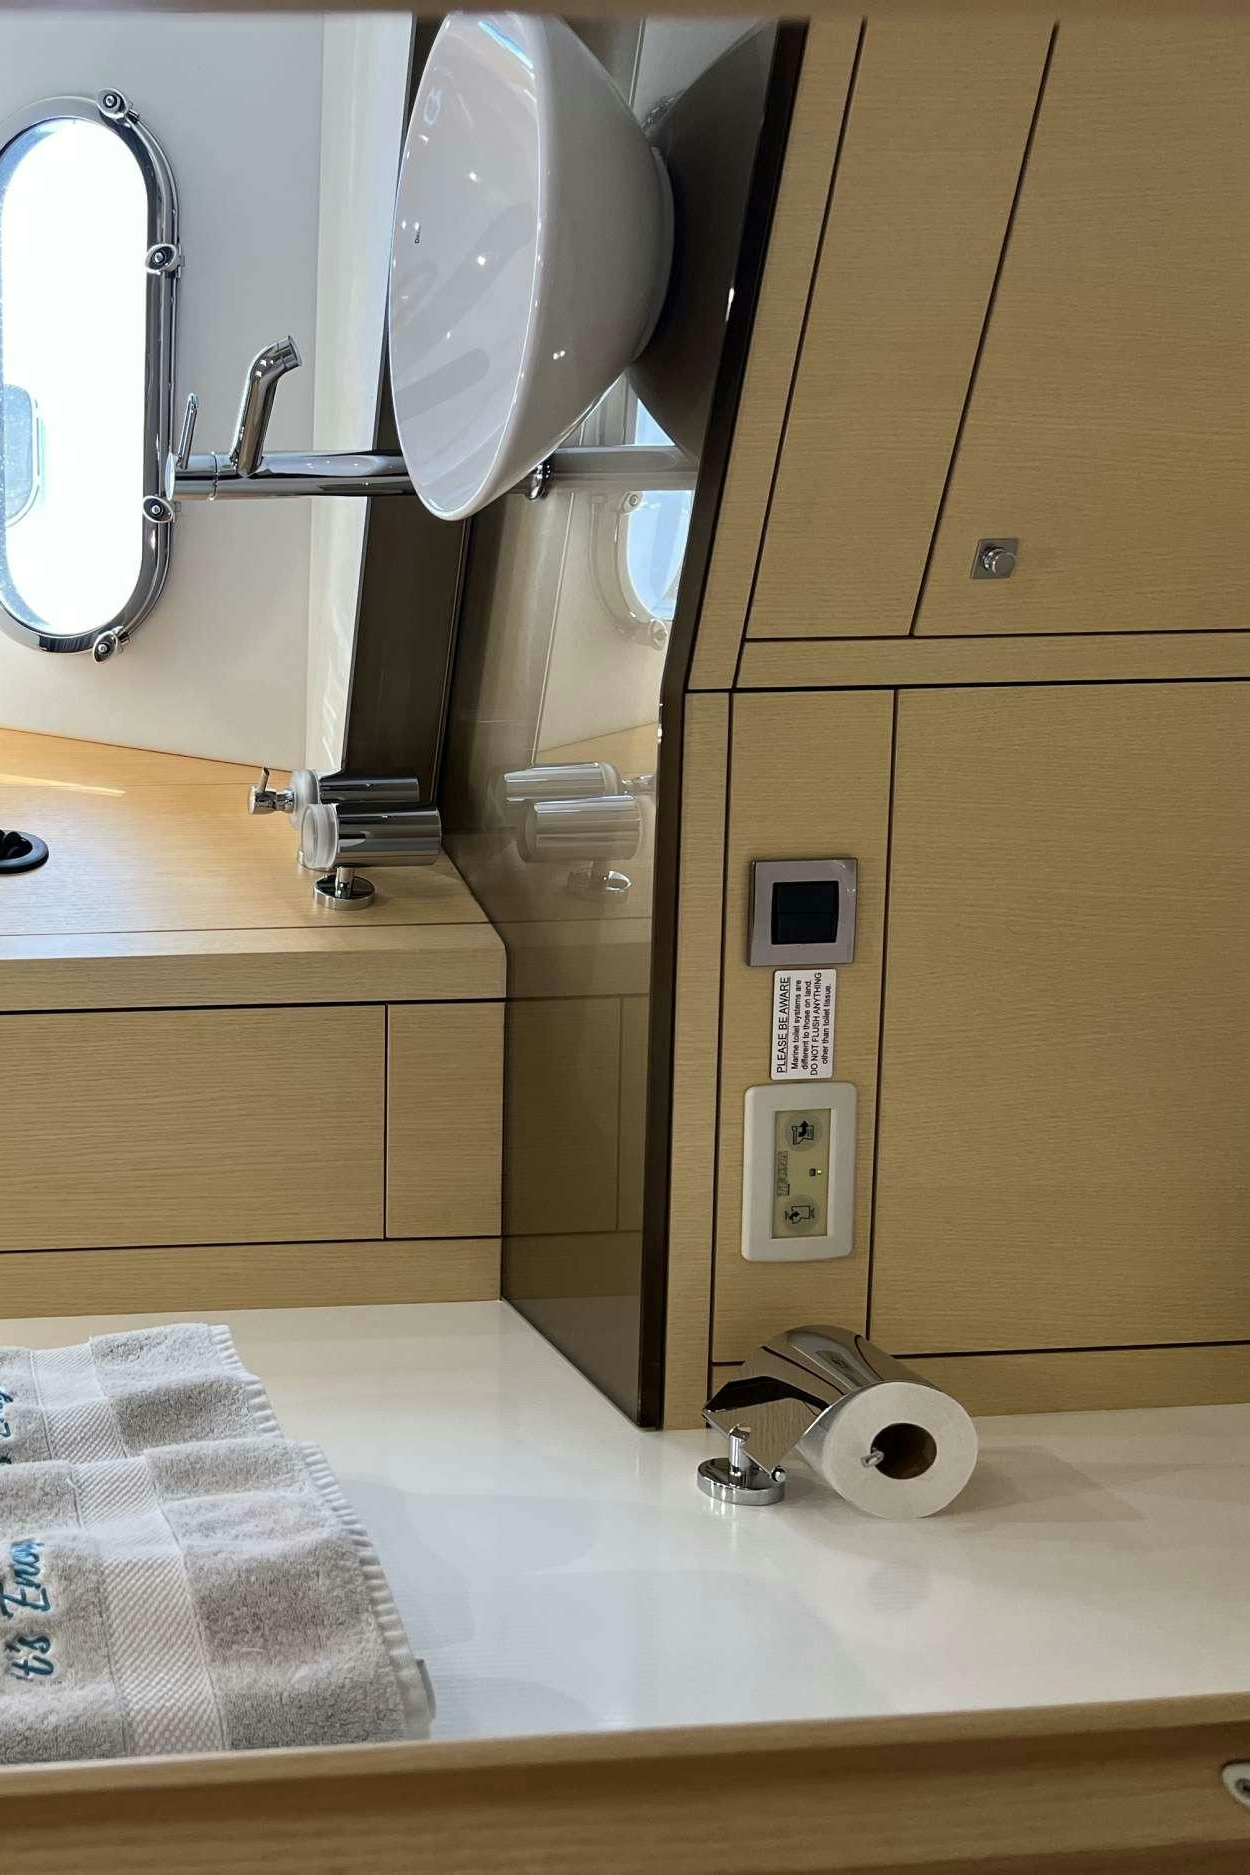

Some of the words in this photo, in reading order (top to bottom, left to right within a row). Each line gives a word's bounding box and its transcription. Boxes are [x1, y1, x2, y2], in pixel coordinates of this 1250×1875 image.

[779, 977, 789, 1014] AWARE
[805, 999, 810, 1008] on
[794, 994, 802, 1023] systems
[779, 1016, 787, 1030] BE
[812, 1016, 820, 1042] FLUSH
[777, 1033, 787, 1073] PLEASE
[791, 1045, 799, 1069] Marine
[811, 1064, 818, 1075] DO
